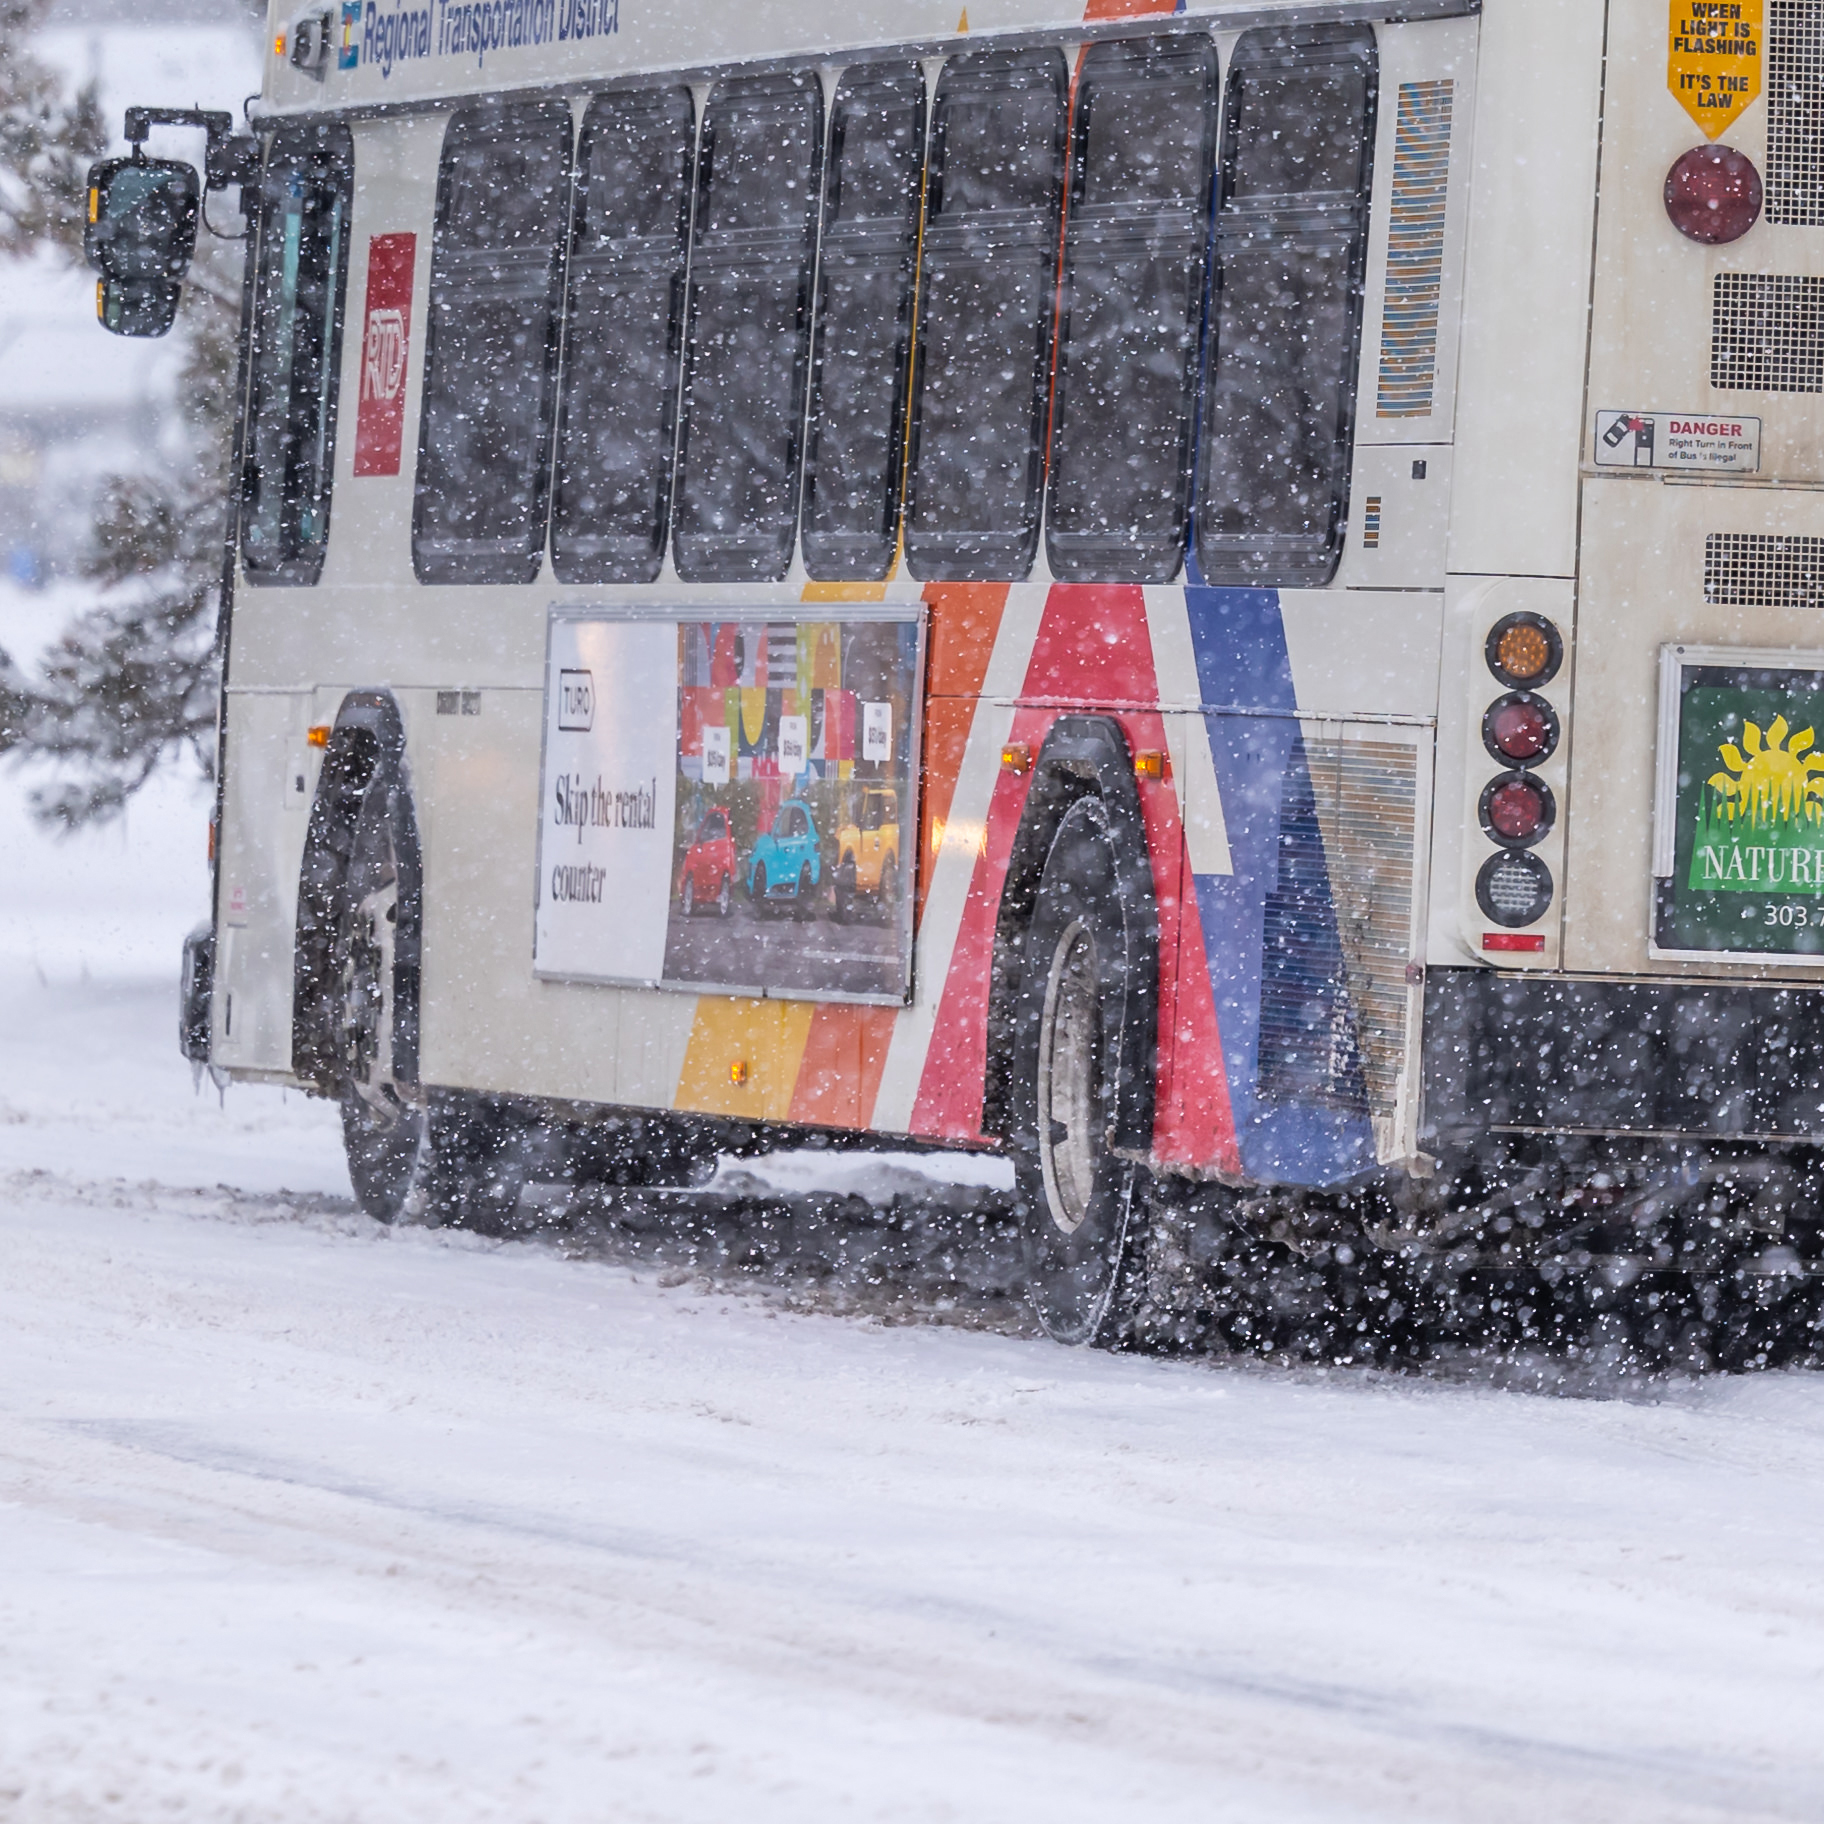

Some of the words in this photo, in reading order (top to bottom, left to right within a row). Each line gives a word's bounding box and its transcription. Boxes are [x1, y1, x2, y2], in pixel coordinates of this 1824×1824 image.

[1692, 2, 1741, 19] WHEN
[1680, 20, 1728, 37] LIGHT
[1734, 22, 1750, 38] IS
[1674, 37, 1756, 56] FLASHING
[1680, 74, 1711, 90] IT'S
[1717, 76, 1749, 92] THE
[1697, 93, 1733, 108] LAW
[363, 308, 406, 401] RTD
[1670, 421, 1742, 437] DANGER
[1669, 438, 1693, 449] Right
[1695, 440, 1715, 448] Turn
[1728, 441, 1753, 450] Front
[1668, 451, 1678, 459] of
[1680, 451, 1697, 460] Bus
[564, 686, 591, 716] TURO
[554, 773, 588, 845] Skip
[591, 774, 613, 827] the
[615, 776, 657, 829] rental
[552, 861, 607, 904] counter
